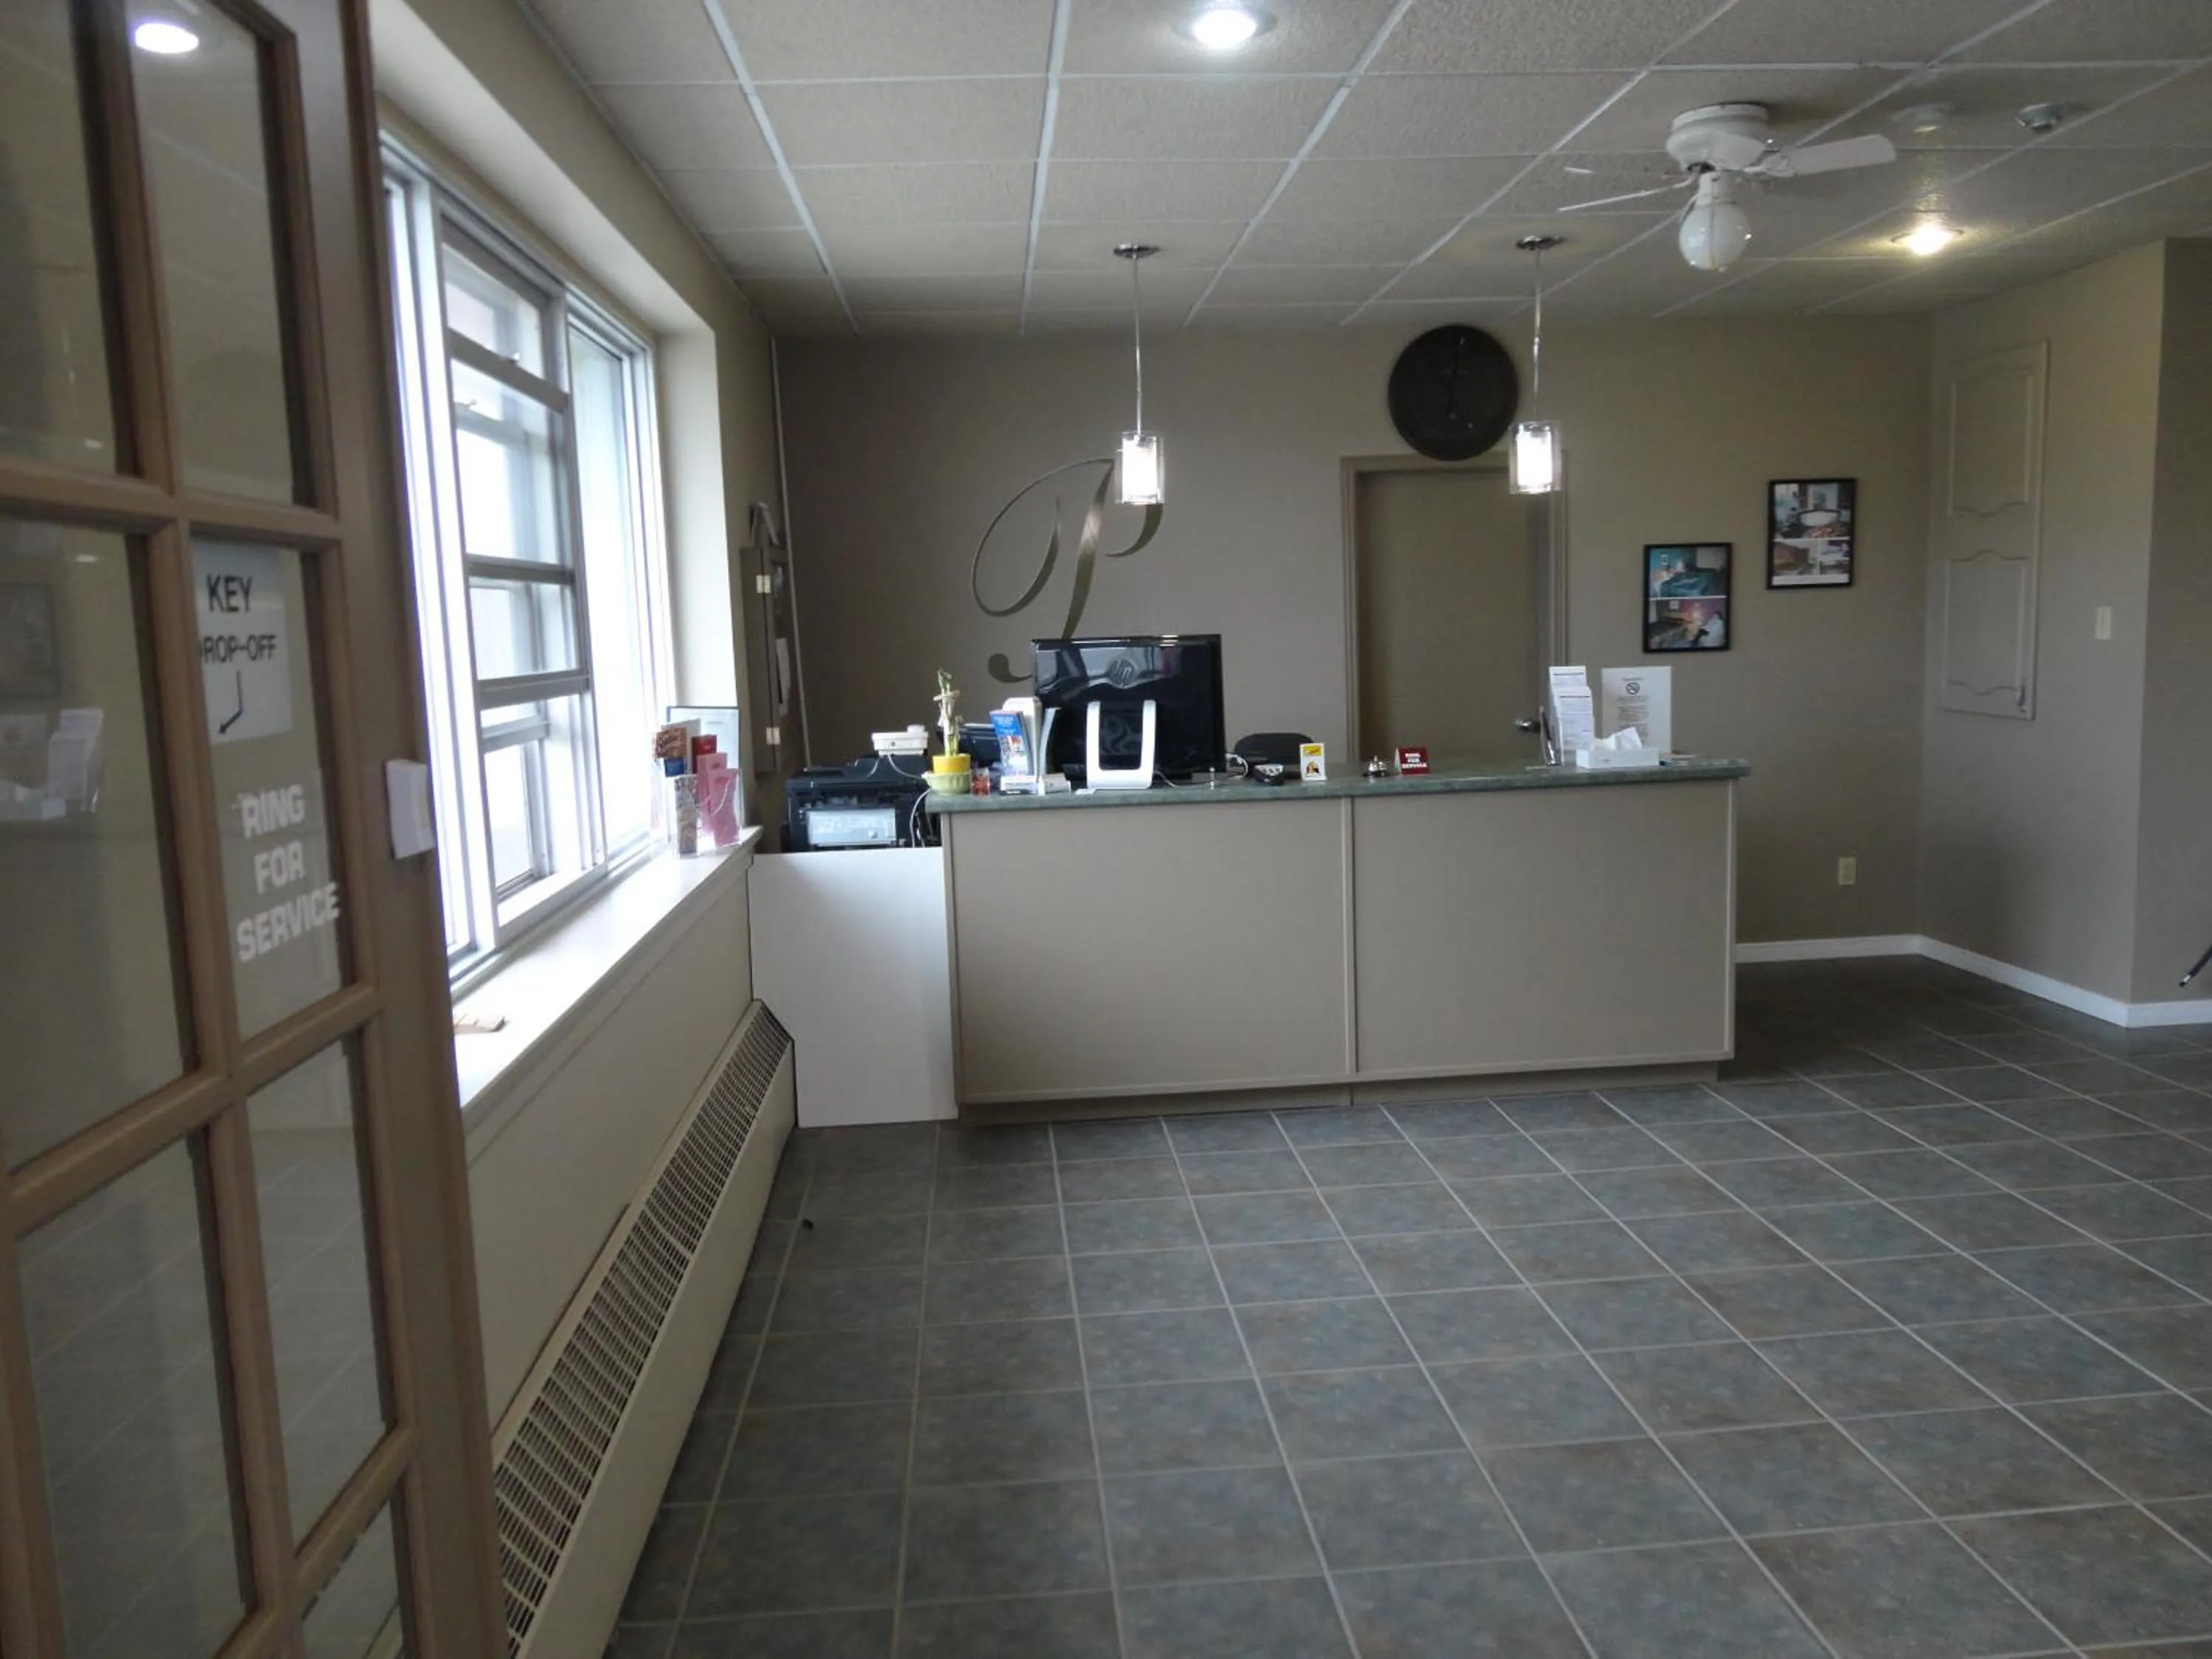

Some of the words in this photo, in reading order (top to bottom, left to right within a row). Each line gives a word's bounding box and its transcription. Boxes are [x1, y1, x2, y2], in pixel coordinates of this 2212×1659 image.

[206, 573, 253, 613] KEY
[199, 633, 277, 663] ROP-OFF
[240, 783, 306, 839] RING
[254, 841, 306, 896] FOR
[236, 881, 341, 963] SERVICE
